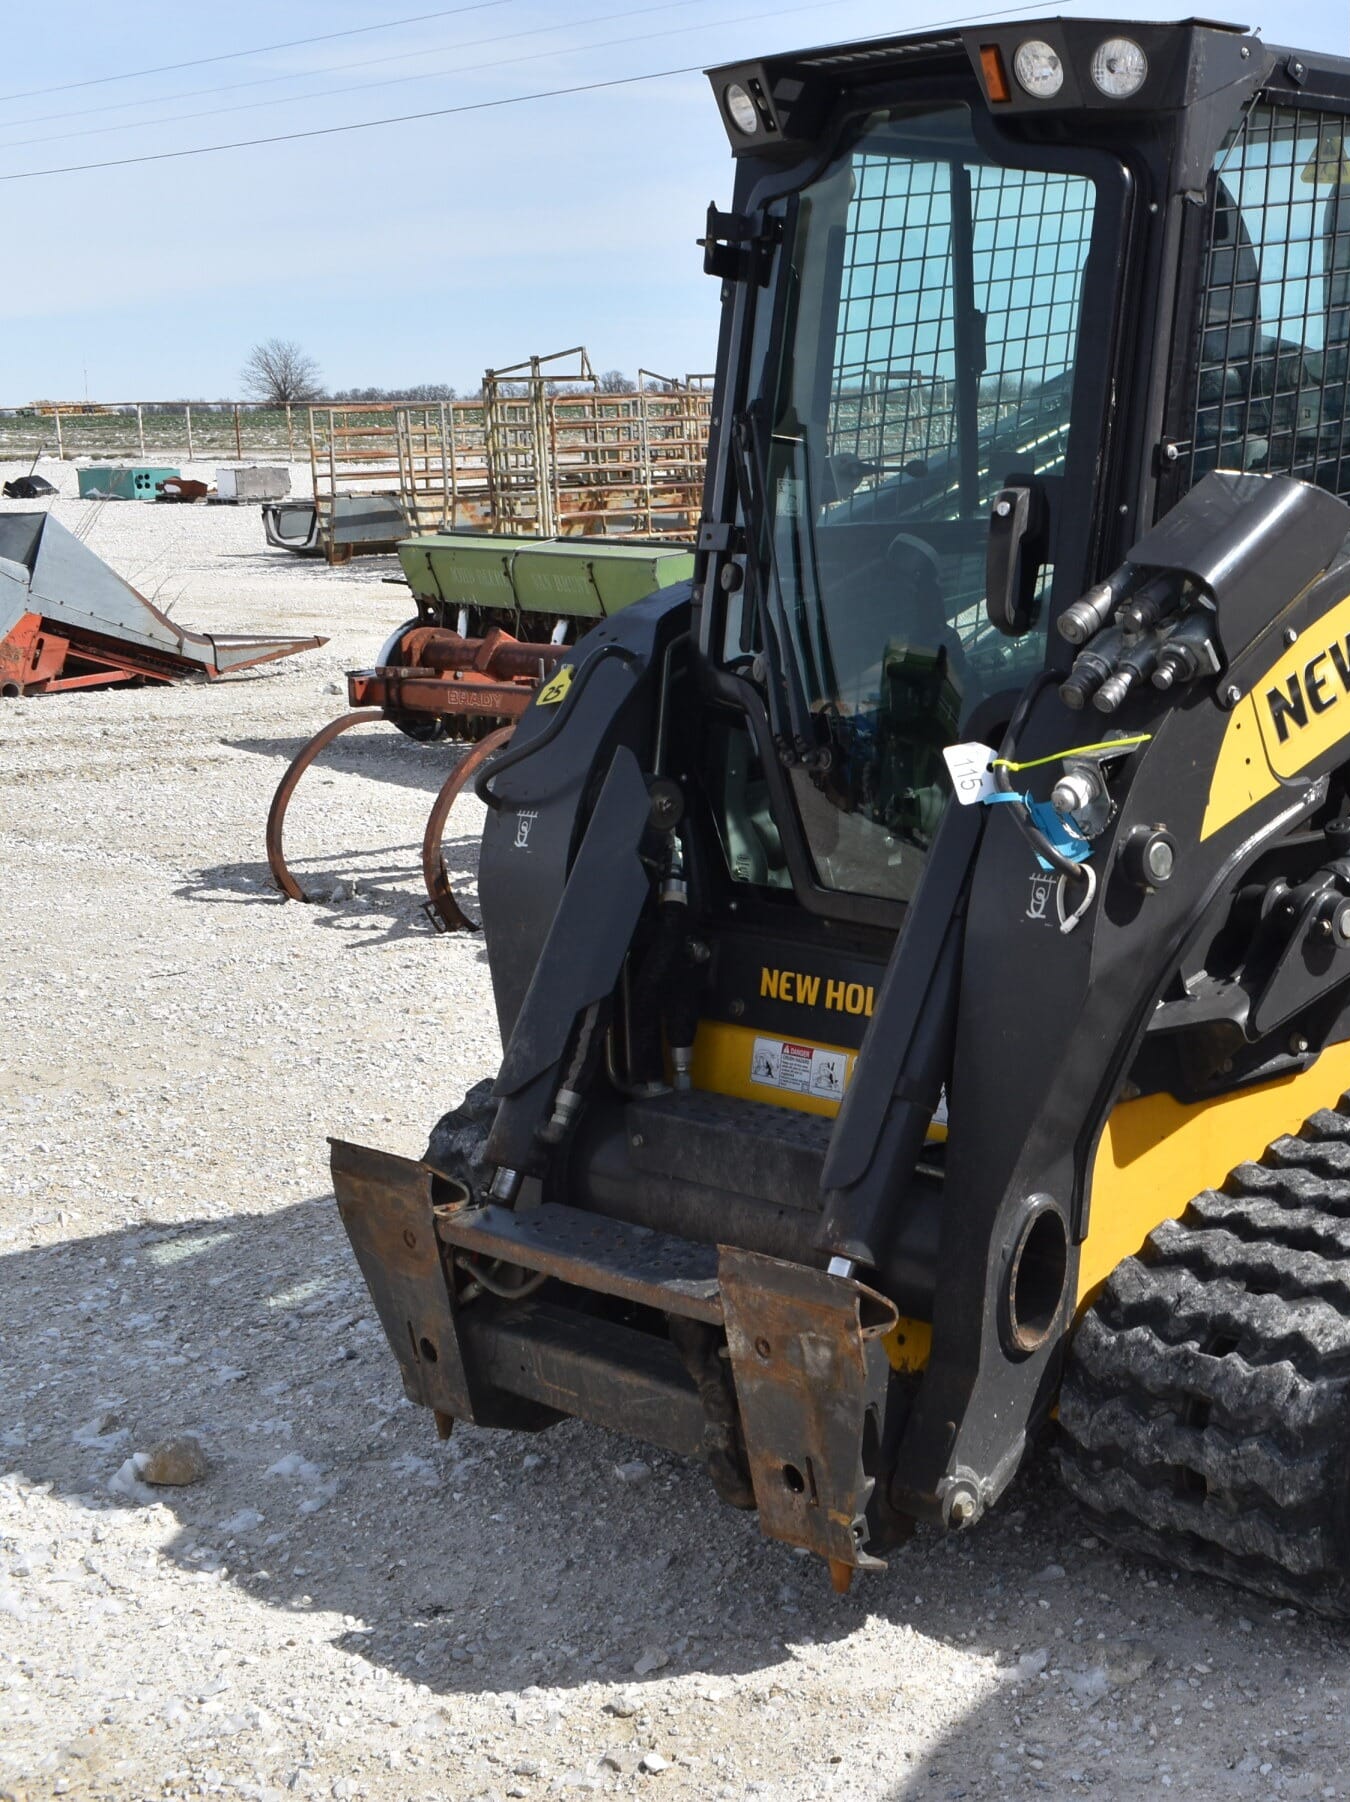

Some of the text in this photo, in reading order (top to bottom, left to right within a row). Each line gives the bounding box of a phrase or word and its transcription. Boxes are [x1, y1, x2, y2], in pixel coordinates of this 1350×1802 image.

[448, 690, 503, 706] BRADY
[543, 684, 564, 702] 25
[953, 758, 983, 790] 115
[760, 967, 821, 1006] NEW
[790, 1046, 811, 1058] DANGER
